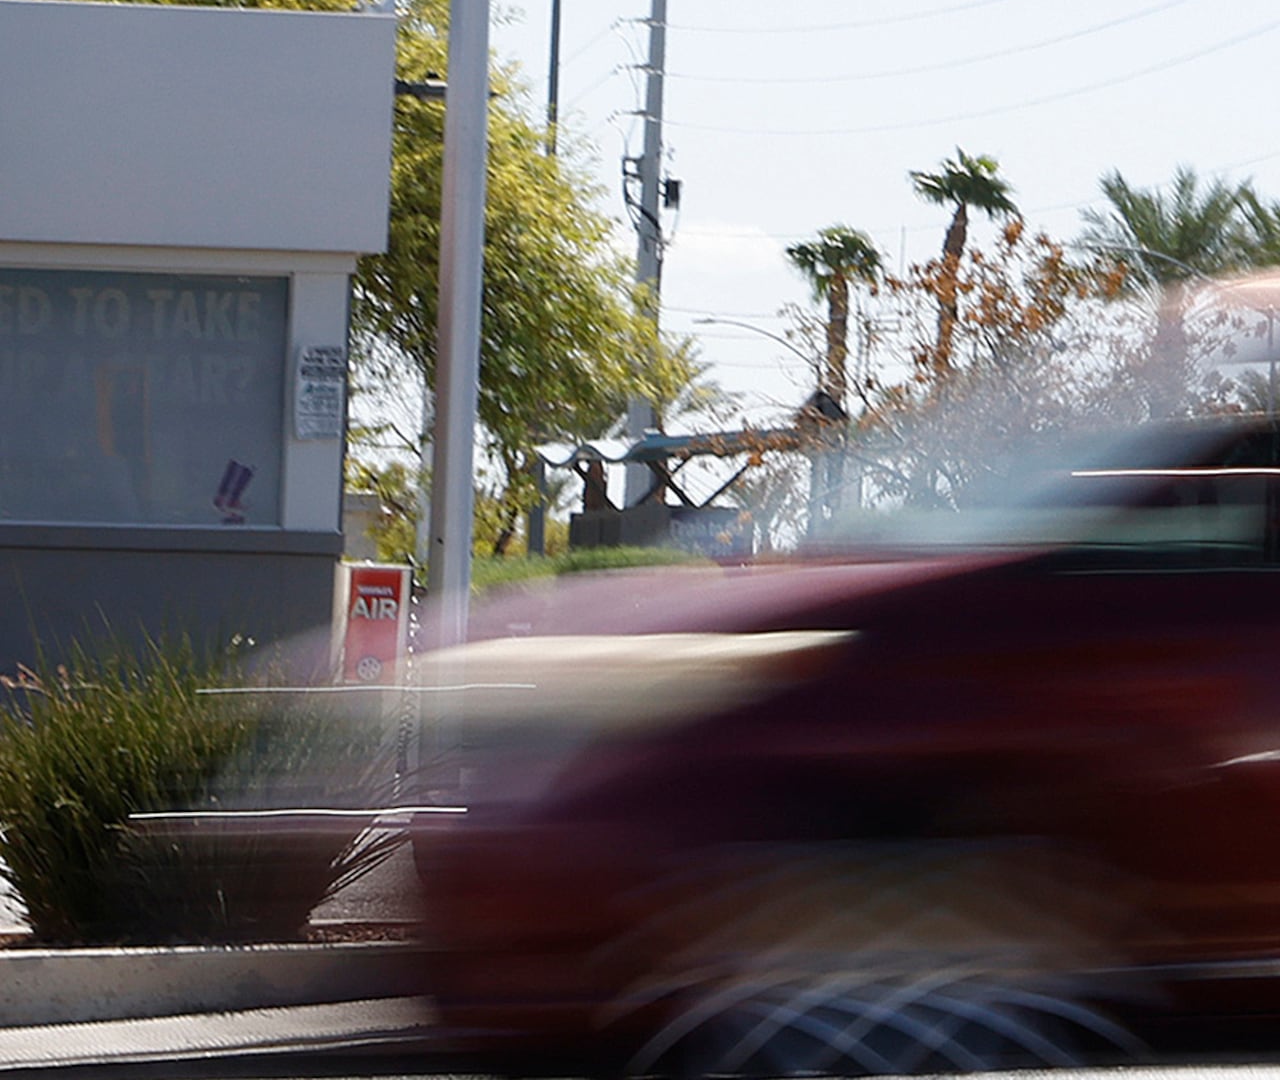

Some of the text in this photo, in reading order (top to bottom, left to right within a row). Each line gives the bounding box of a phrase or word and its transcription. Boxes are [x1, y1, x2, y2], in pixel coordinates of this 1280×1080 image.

[69, 287, 130, 339] TO
[147, 289, 261, 340] TAKE
[351, 597, 398, 620] AIR
